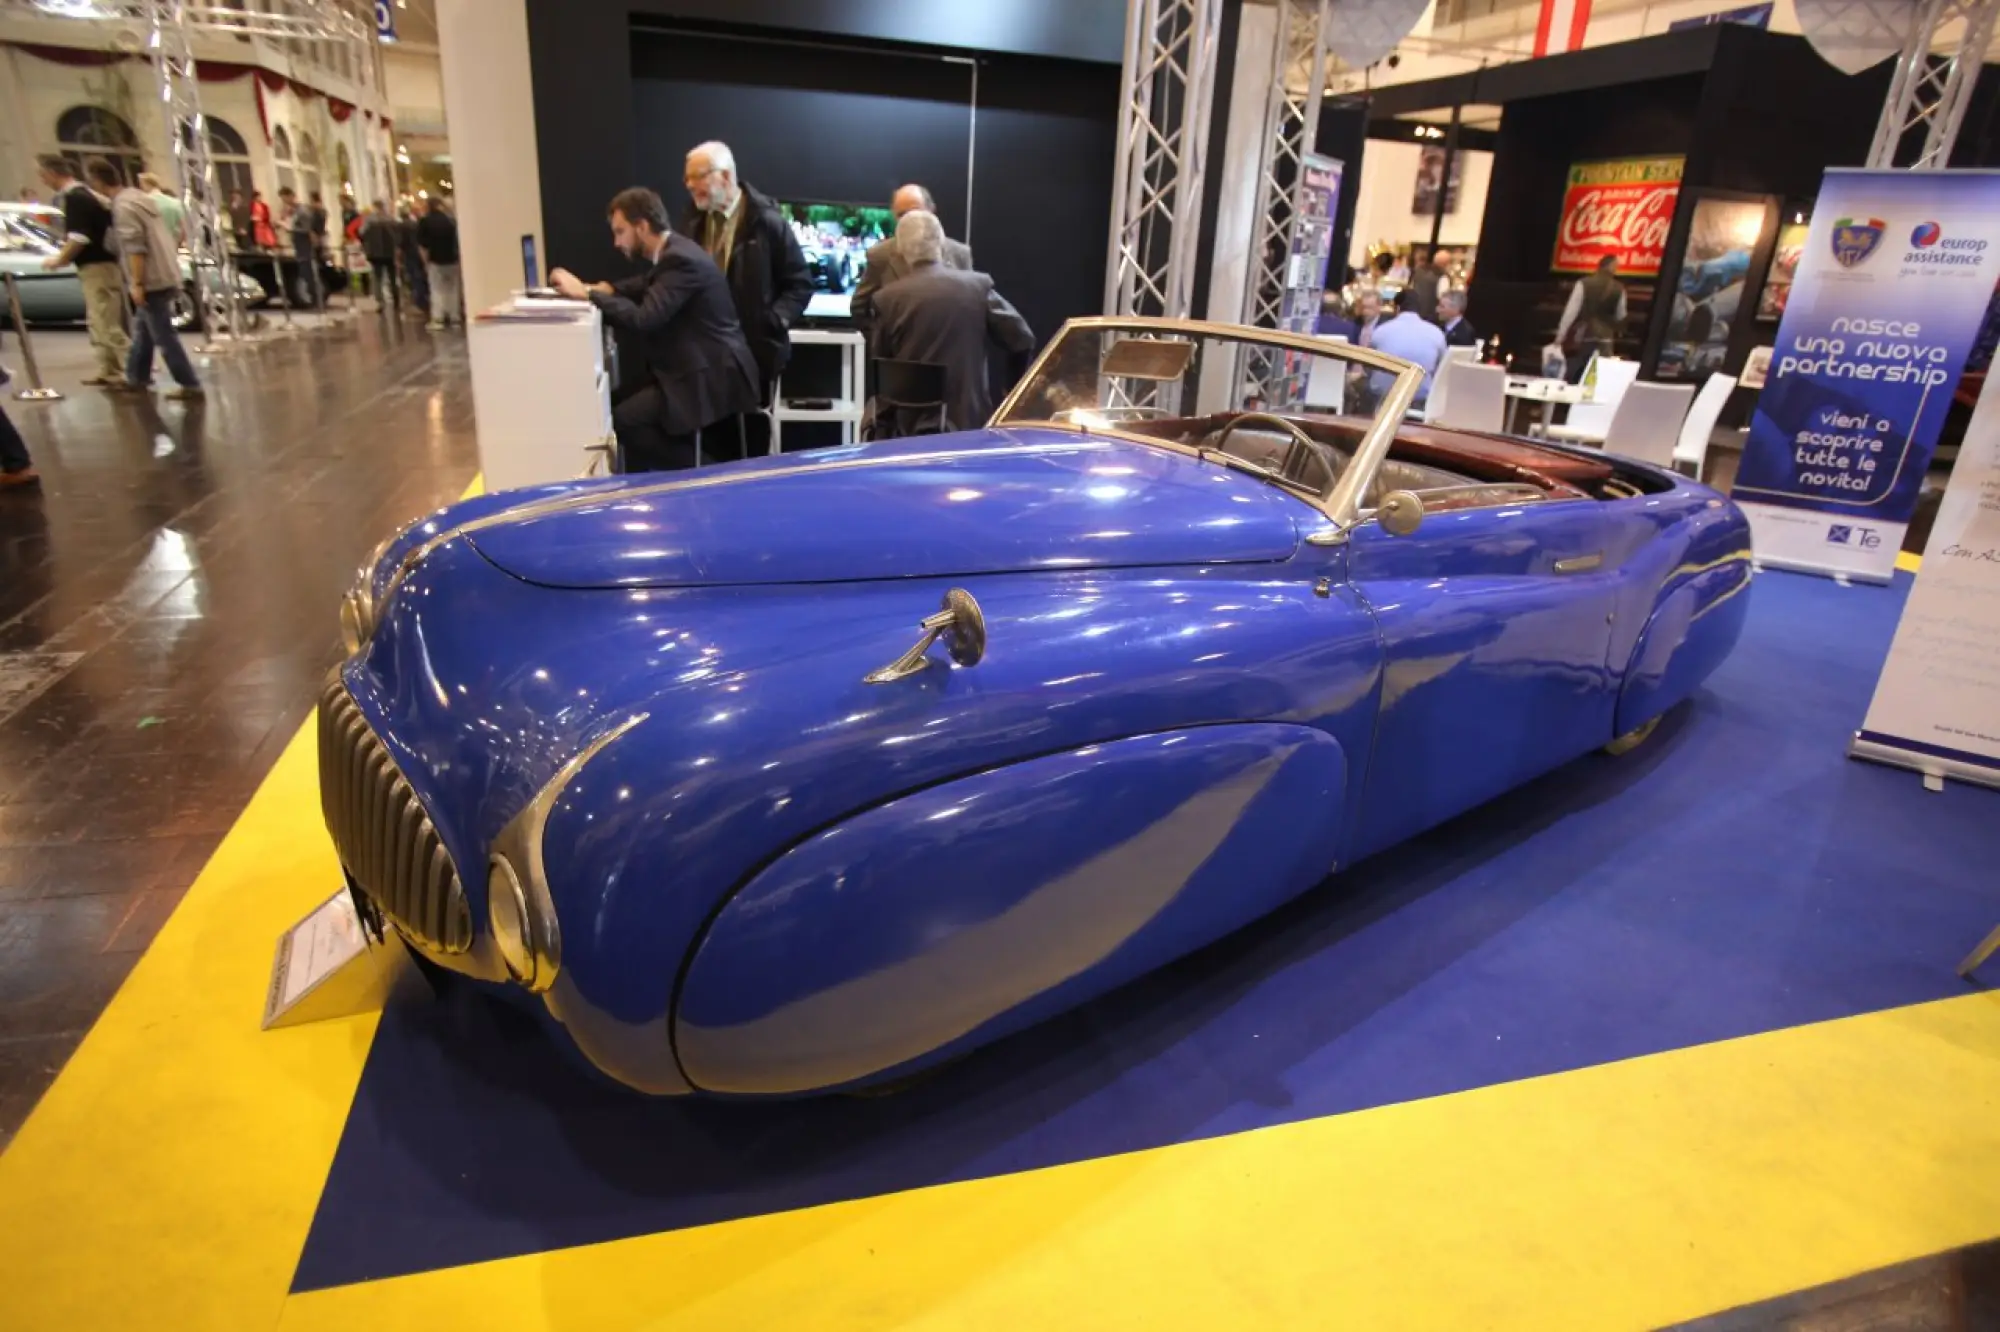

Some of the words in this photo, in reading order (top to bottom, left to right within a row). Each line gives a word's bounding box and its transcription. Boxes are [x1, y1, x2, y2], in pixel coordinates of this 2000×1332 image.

[1940, 237, 1988, 252] europ
[1903, 250, 1984, 266] assistance
[1831, 316, 1921, 338] nasce
[1794, 336, 1845, 355] una
[1855, 341, 1948, 363] nuova
[1776, 354, 1948, 386] partnership
[1820, 409, 1870, 430] vieni
[1875, 419, 1890, 432] a
[1795, 430, 1884, 455] scoprire
[1795, 447, 1850, 468] tutte
[1856, 454, 1876, 471] le
